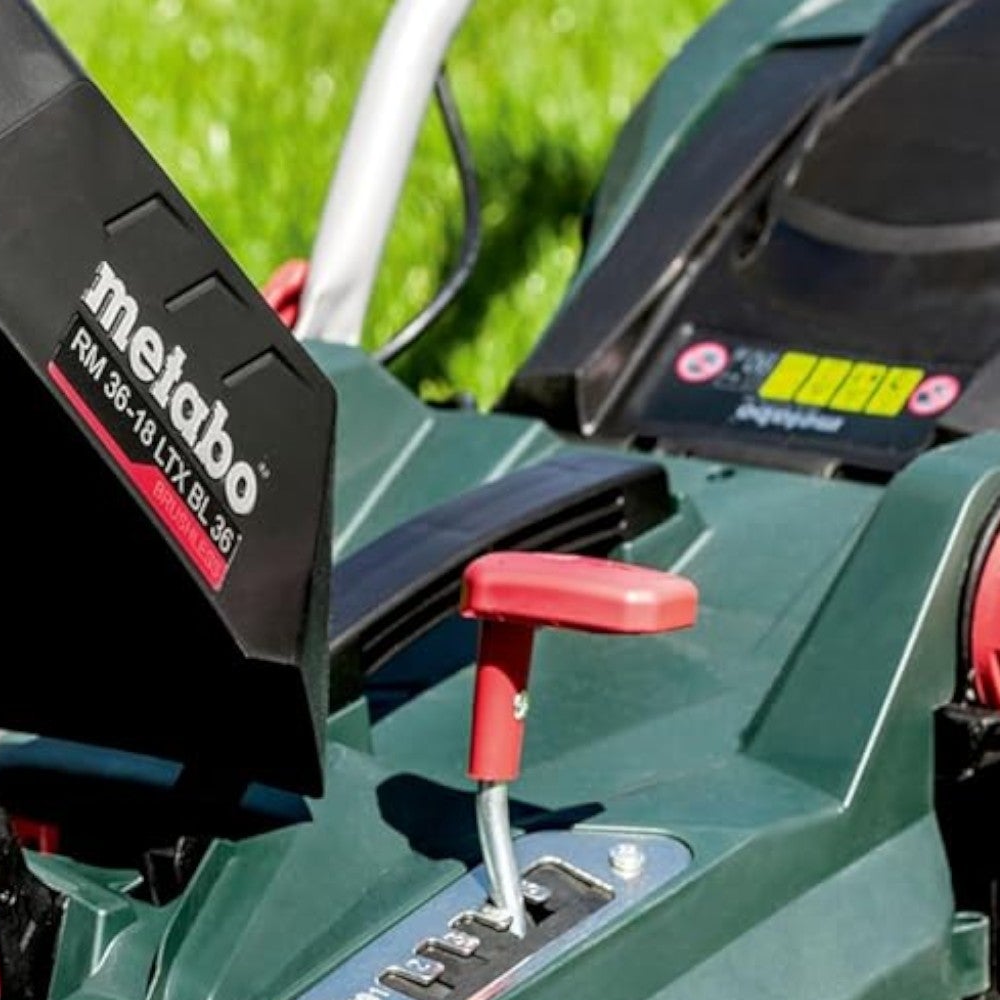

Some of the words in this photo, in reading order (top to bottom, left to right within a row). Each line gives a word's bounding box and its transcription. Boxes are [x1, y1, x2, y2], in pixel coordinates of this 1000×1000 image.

[69, 326, 104, 382] RM
[103, 373, 154, 446] 36-18
[153, 435, 192, 494] LTX
[188, 482, 209, 526] BL
[80, 260, 258, 515] metabo
